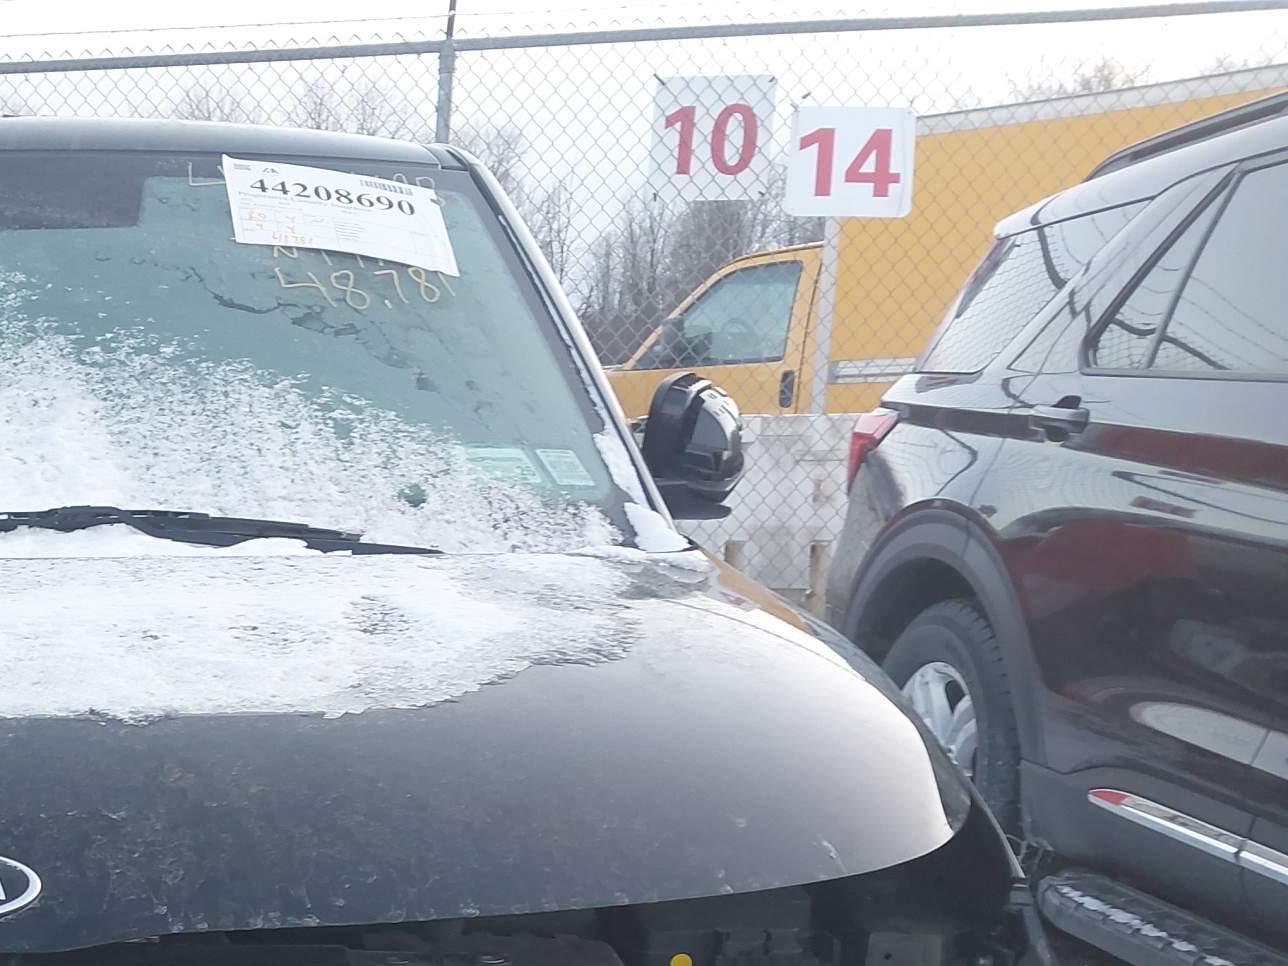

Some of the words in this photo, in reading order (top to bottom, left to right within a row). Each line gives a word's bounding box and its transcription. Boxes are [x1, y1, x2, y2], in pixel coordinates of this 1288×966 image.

[663, 103, 759, 176] 10
[799, 127, 901, 198] 14
[249, 177, 416, 217] 44208690
